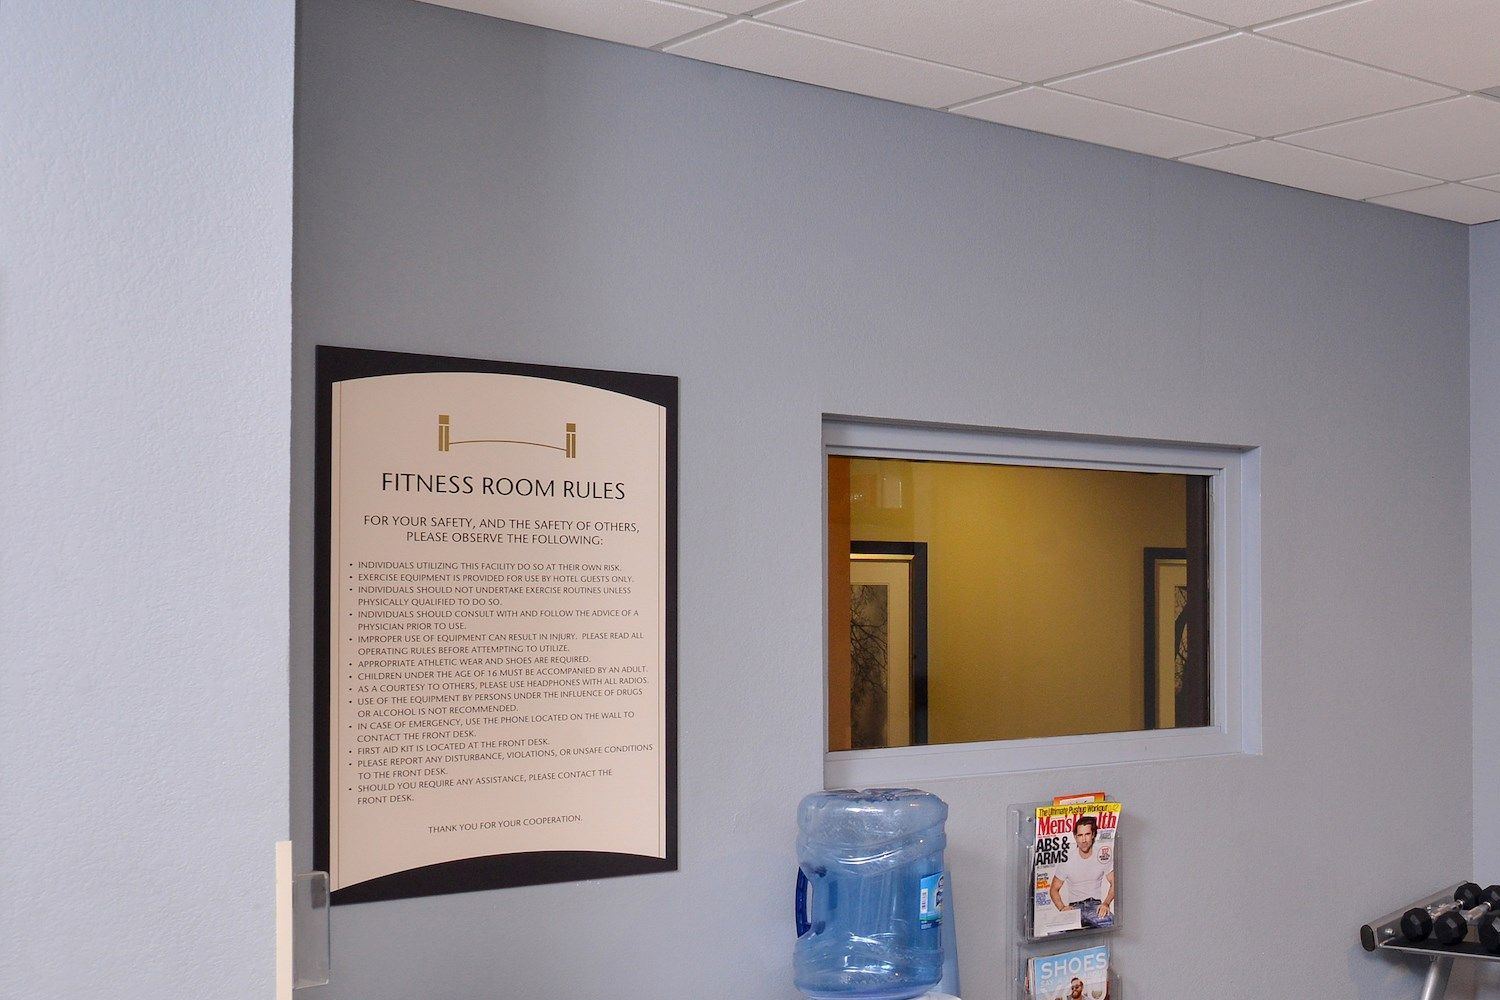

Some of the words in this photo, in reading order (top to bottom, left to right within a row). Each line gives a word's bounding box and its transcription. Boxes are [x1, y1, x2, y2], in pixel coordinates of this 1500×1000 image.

[382, 473, 473, 494] FITNESS
[482, 477, 554, 497] ROOM
[564, 480, 626, 500] RULES
[364, 515, 388, 527] FOR
[392, 515, 428, 528] YOUR
[430, 516, 476, 531] SAFETY,
[478, 518, 506, 530] AND
[508, 518, 530, 530] THE
[533, 519, 574, 531] SAFETY
[576, 520, 592, 532] OF
[593, 521, 640, 535] OTHERS,
[406, 531, 448, 543] PLEASE
[451, 532, 504, 544] OBSERVE
[506, 533, 528, 545] THE
[532, 533, 604, 546] FOLLOWING:
[358, 561, 414, 570] INDIVIDUALS
[416, 562, 458, 570] UTILIZING
[461, 562, 479, 570] THIS
[481, 562, 516, 571] FACILITY
[517, 563, 530, 571] DO
[533, 563, 544, 571] SO
[546, 563, 556, 571] AT
[558, 563, 580, 571] THEIR
[581, 563, 601, 572] OWN
[603, 564, 622, 572] RISK.
[358, 573, 398, 582] EXERCISE
[400, 574, 451, 582] EQUIPMENT
[453, 574, 461, 582] IS
[462, 574, 505, 582] PROVIDED
[507, 574, 523, 583] FOR
[525, 575, 539, 583] USE
[541, 575, 551, 583] BY
[553, 575, 578, 583] HOTEL
[580, 575, 610, 583] GUESTS
[611, 575, 634, 583] ONLY.
[358, 586, 414, 594] INDIVIDUALS
[416, 586, 452, 594] SHOULD
[455, 586, 473, 594] NOT
[475, 586, 524, 594] UNDERTAKE
[526, 586, 561, 594] EXERCISE
[563, 586, 601, 594] ROUTINES
[603, 587, 631, 595] UNLESS
[358, 598, 409, 606] PHYSICALLY
[411, 598, 456, 606] QUALIFIED
[458, 598, 470, 606] TO
[472, 598, 486, 606] DO
[488, 598, 502, 606] SO.
[358, 610, 414, 618] INDIVIDUALS
[416, 610, 452, 618] SHOULD
[455, 610, 494, 618] CONSULT
[496, 610, 518, 618] WITH
[520, 609, 537, 617] AND
[540, 609, 573, 617] FOLLOW
[575, 609, 590, 617] THE
[592, 609, 619, 617] ADVICE
[621, 609, 632, 617] OF
[633, 609, 639, 617] A
[358, 623, 404, 631] PHYSICIAN
[406, 622, 431, 631] PRIOR
[434, 622, 446, 630] TO
[449, 622, 467, 630] USE.
[358, 671, 402, 680] CHILDREN
[404, 670, 434, 679] UNDER
[437, 670, 452, 678] THE
[454, 669, 471, 678] AGE
[473, 669, 485, 677] OF
[488, 669, 497, 677] 16
[500, 668, 523, 677] MUST
[525, 668, 534, 676] BE
[537, 666, 595, 676] ACCOMPANIED
[598, 666, 607, 674] BY
[609, 666, 620, 674] AN
[621, 665, 648, 674] ADULT.
[357, 746, 380, 755] FIRST
[383, 745, 398, 754] AID
[401, 744, 413, 753] KIT
[416, 744, 424, 752] IS
[426, 742, 465, 752] LOCATED
[468, 741, 479, 750] AT
[481, 740, 496, 749] THE
[498, 739, 525, 748] FRONT
[527, 737, 549, 746] DESK.
[1039, 808, 1048, 816] The
[428, 824, 457, 834] THANK
[459, 822, 478, 832] YOU
[480, 821, 496, 830] FOR
[498, 819, 521, 829] YOUR
[523, 814, 582, 826] COOPERATION.
[1038, 816, 1072, 836] Men's
[1036, 838, 1060, 852] ABS
[1061, 836, 1070, 850] &
[1035, 850, 1068, 866] ARMS
[1041, 952, 1107, 979] SHOES
